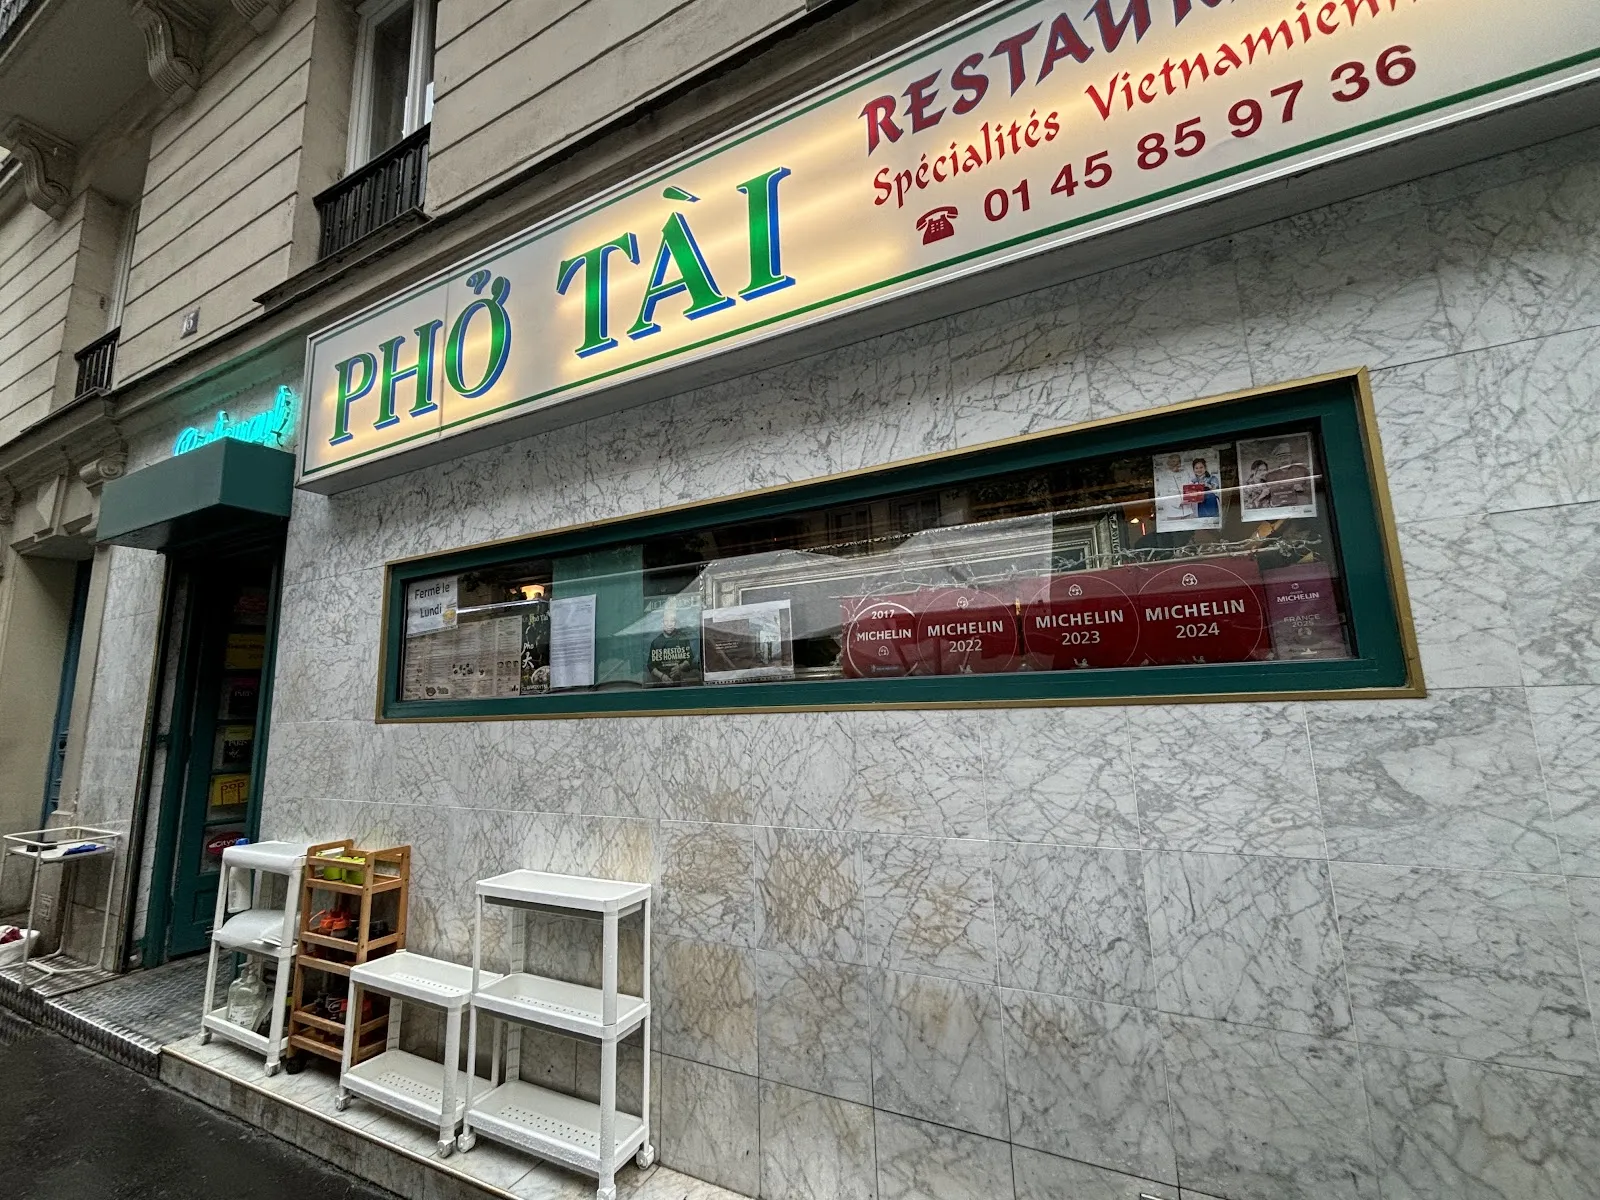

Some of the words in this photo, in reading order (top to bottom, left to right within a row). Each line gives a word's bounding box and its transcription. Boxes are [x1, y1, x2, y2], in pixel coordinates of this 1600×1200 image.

[873, 112, 1060, 208] Spécialités
[1085, 0, 1416, 121] Vietnamien
[983, 179, 1031, 222] 01
[1050, 151, 1113, 198] 45
[1137, 116, 1206, 170] 85
[1228, 80, 1304, 138] 97
[1331, 45, 1416, 102] 36
[329, 270, 511, 447] PHỞ
[557, 166, 797, 359] TÀI
[442, 582, 450, 594] le
[1276, 591, 1319, 603] MICHELIN
[420, 604, 442, 618] Lundi
[871, 609, 895, 620] 2017
[1145, 599, 1245, 622] MICHELIN
[1283, 613, 1320, 622] FRANCE
[1035, 609, 1124, 629] MICHELIN
[856, 629, 912, 642] MICHELIN
[927, 620, 1004, 638] MICHELIN
[1176, 622, 1220, 639] 2024
[1061, 630, 1101, 646] 2023
[664, 646, 685, 655] RESTOS
[949, 639, 983, 653] 2022
[651, 654, 662, 662] DES
[663, 652, 691, 661] HOMMES
